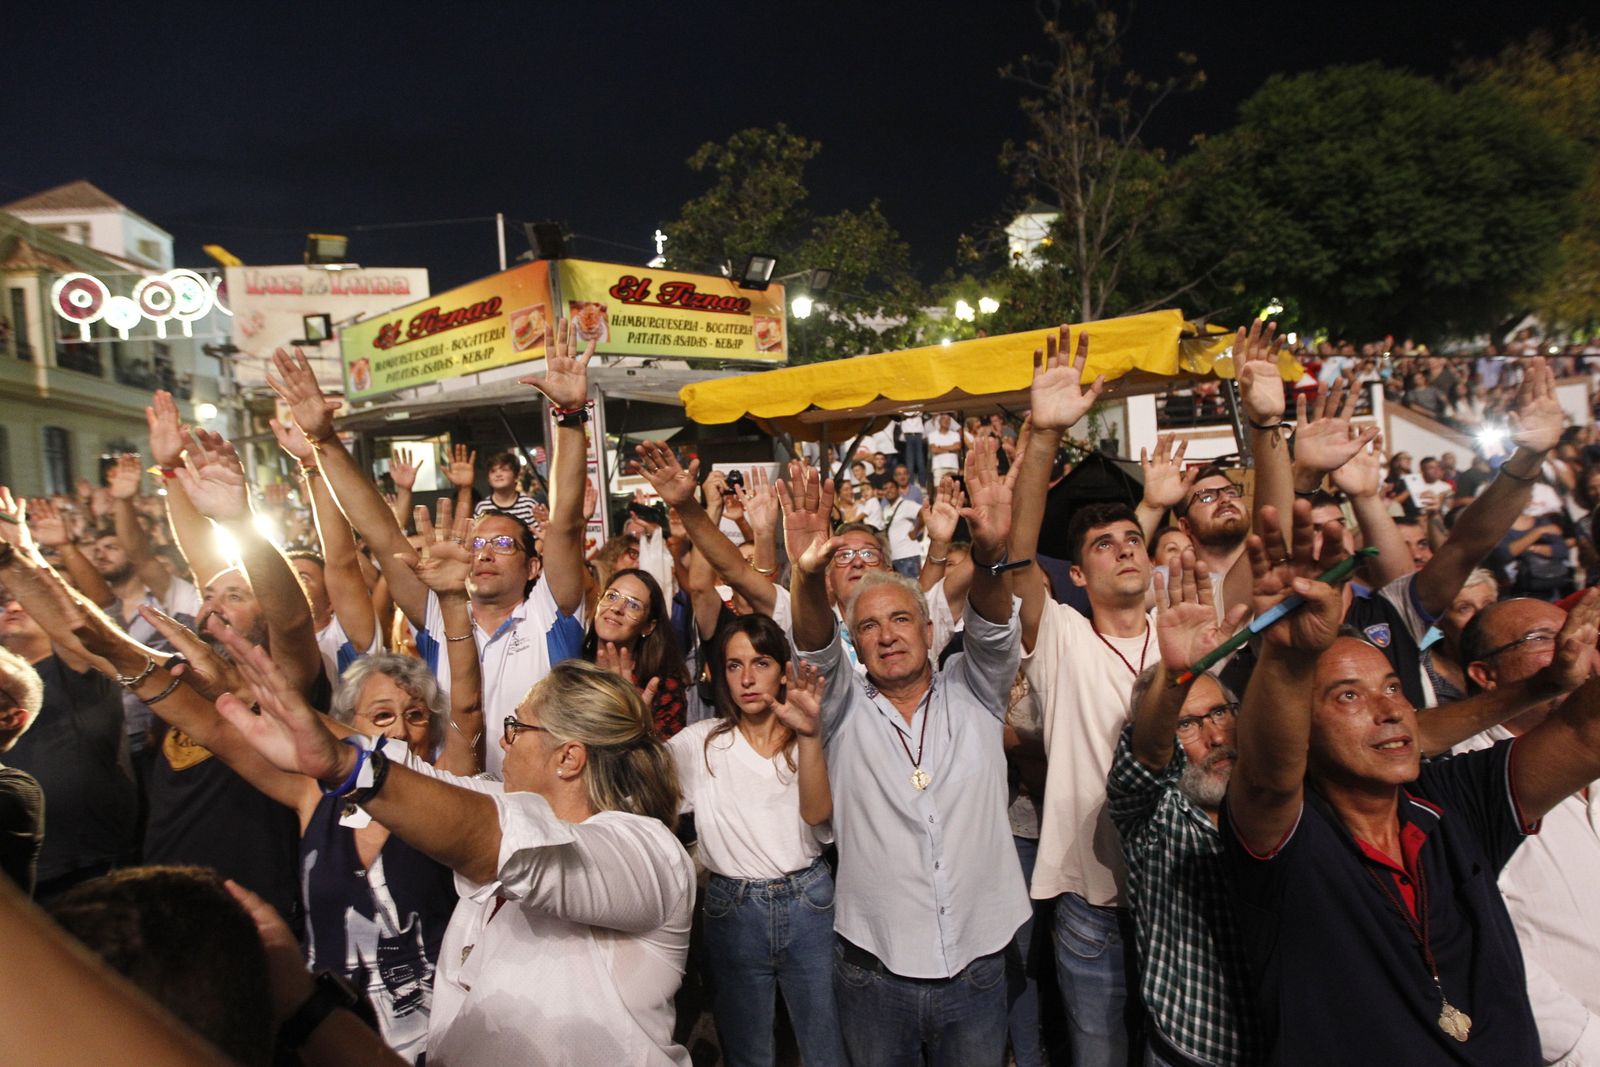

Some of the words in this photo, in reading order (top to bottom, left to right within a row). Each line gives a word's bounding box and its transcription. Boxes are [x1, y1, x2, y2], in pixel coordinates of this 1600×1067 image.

[328, 271, 411, 296] Luna
[609, 275, 653, 302] El
[656, 281, 751, 313] Tiznao
[373, 319, 402, 350] El
[406, 296, 502, 339] Tiznao
[611, 314, 699, 332] HAMBURGUESERIA
[706, 321, 753, 336] BOCATERIA
[452, 326, 506, 351] BOCATERIA
[627, 331, 672, 346] PATATAS
[673, 334, 708, 348] ASADAS
[715, 337, 744, 349] KEBAP
[462, 346, 495, 365] KEBAP
